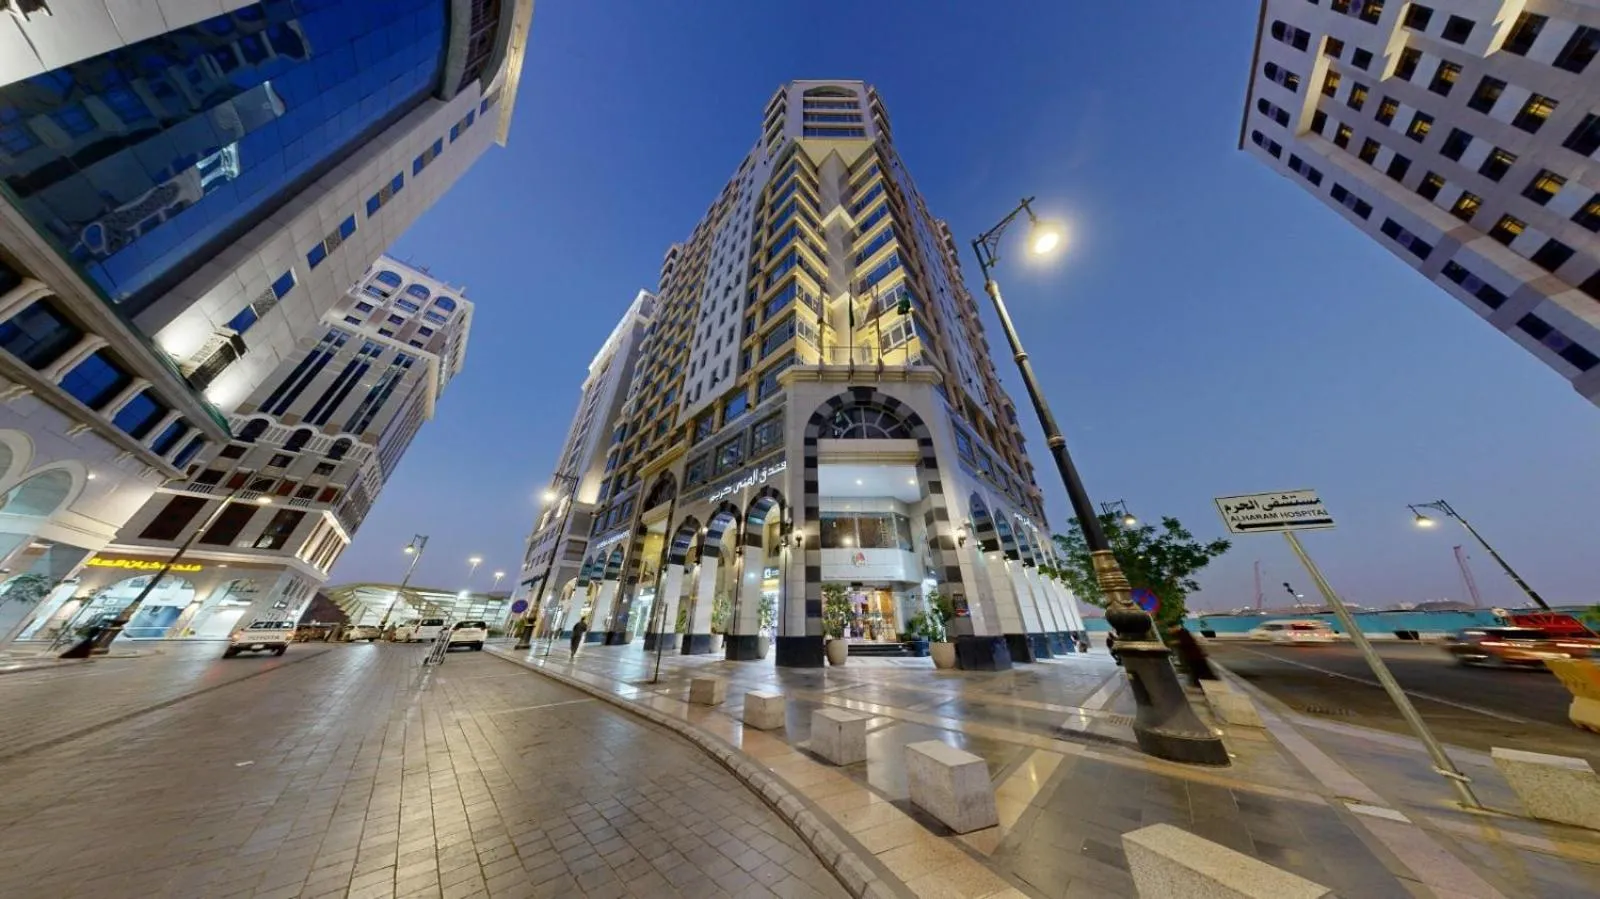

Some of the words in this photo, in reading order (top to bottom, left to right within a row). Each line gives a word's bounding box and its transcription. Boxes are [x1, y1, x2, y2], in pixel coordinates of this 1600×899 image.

[759, 460, 787, 483] فندق
[1224, 499, 1260, 515] الحرم
[1261, 495, 1323, 512] مستشفى
[1229, 513, 1278, 522] ALHARAM
[1280, 508, 1329, 519] HOSPITAL
